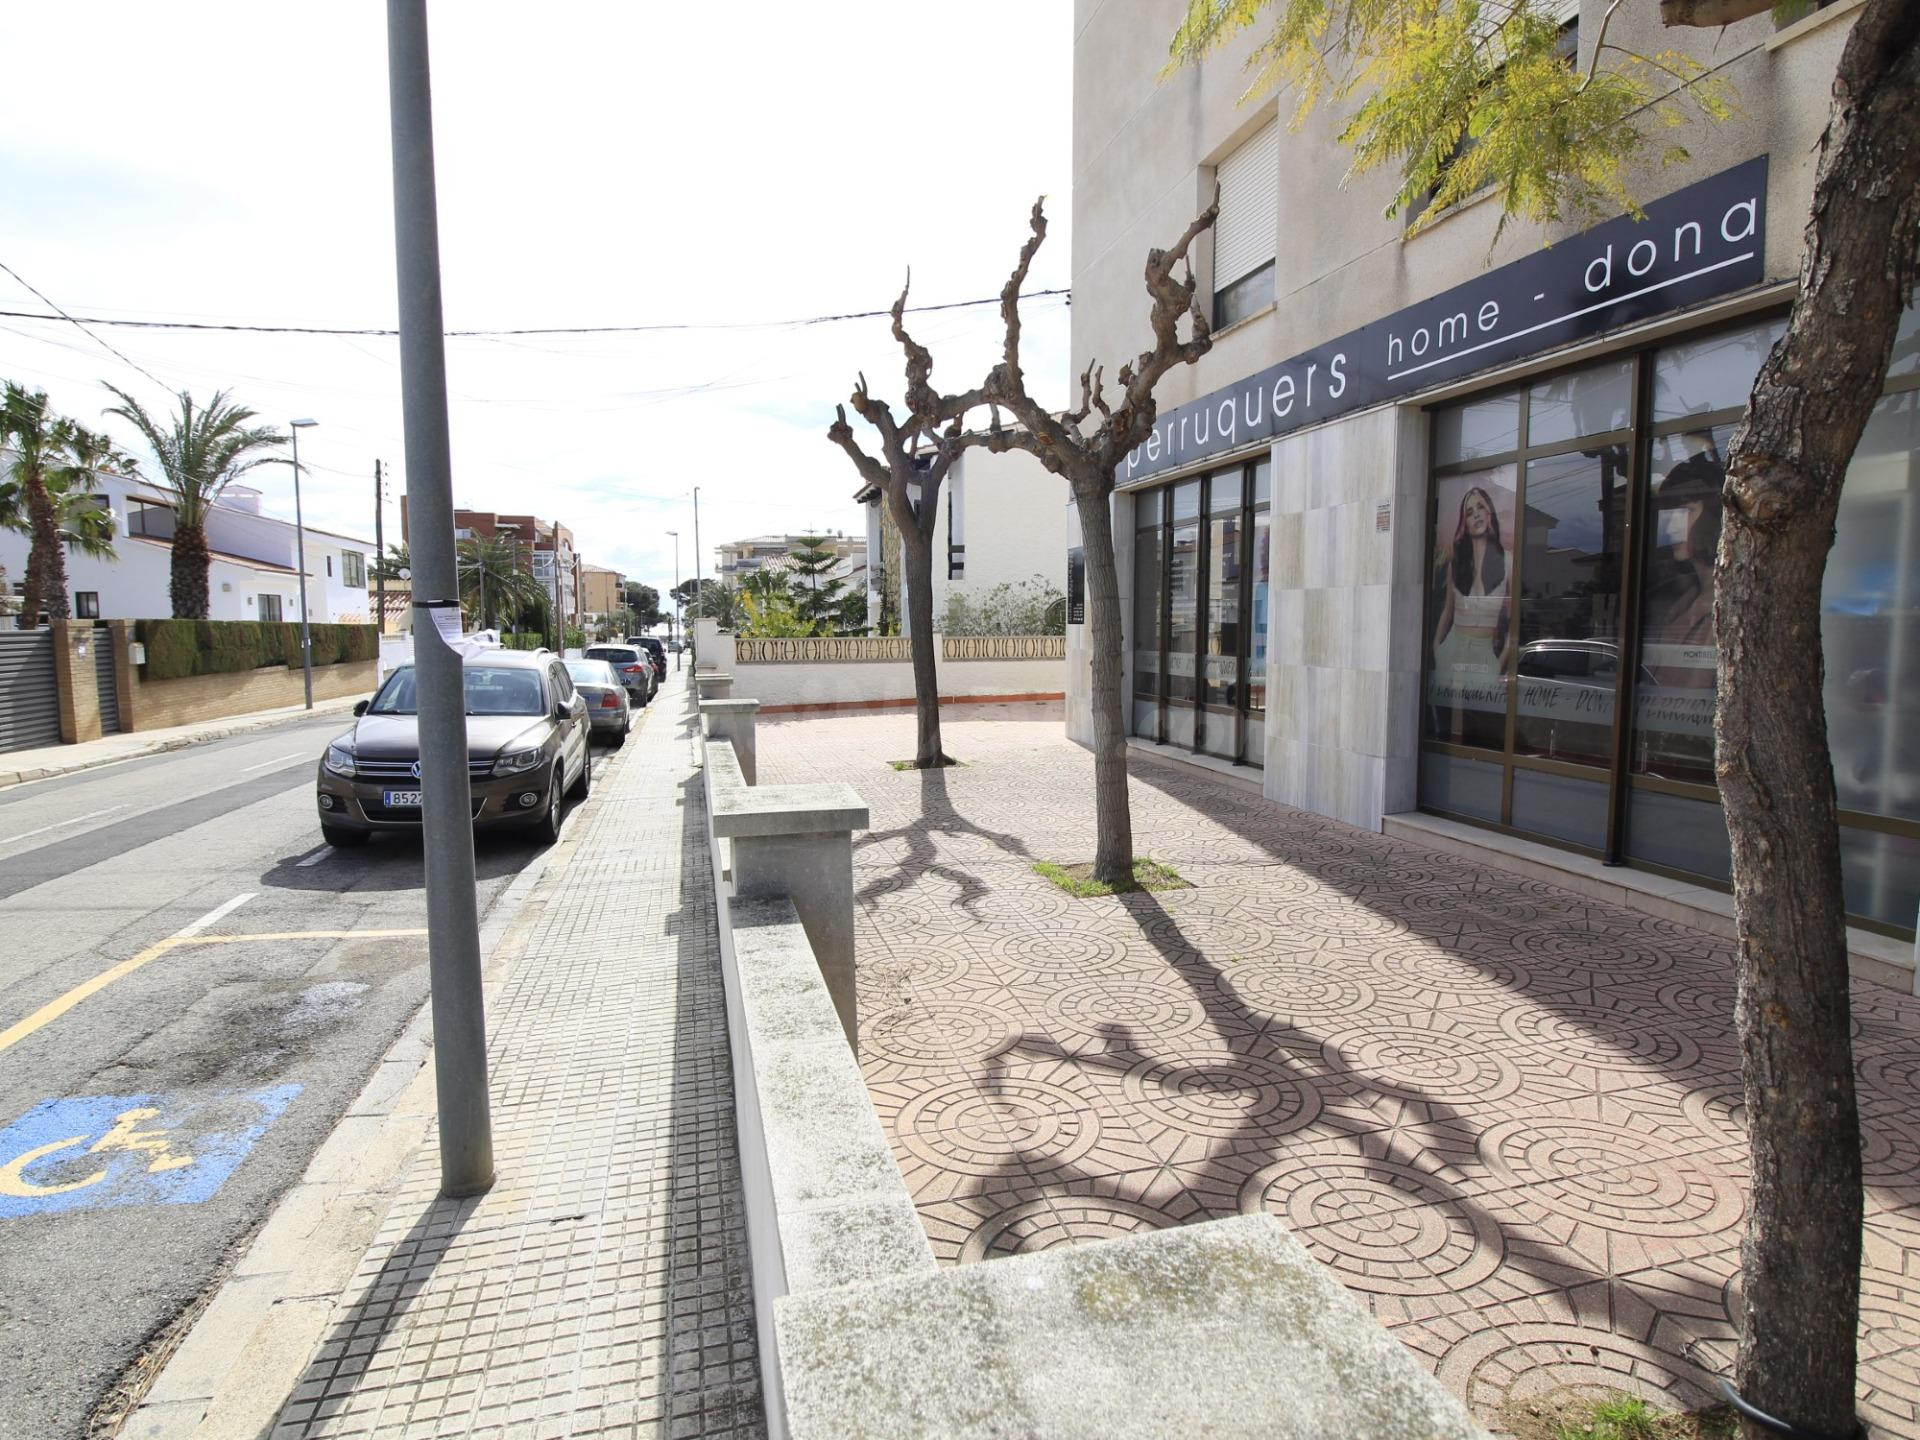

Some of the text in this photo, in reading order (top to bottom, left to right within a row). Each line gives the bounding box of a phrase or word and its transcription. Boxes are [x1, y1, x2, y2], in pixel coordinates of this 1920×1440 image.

[1127, 353, 1346, 478] perruquers
[1387, 299, 1500, 366] home
[1584, 197, 1757, 293] dona
